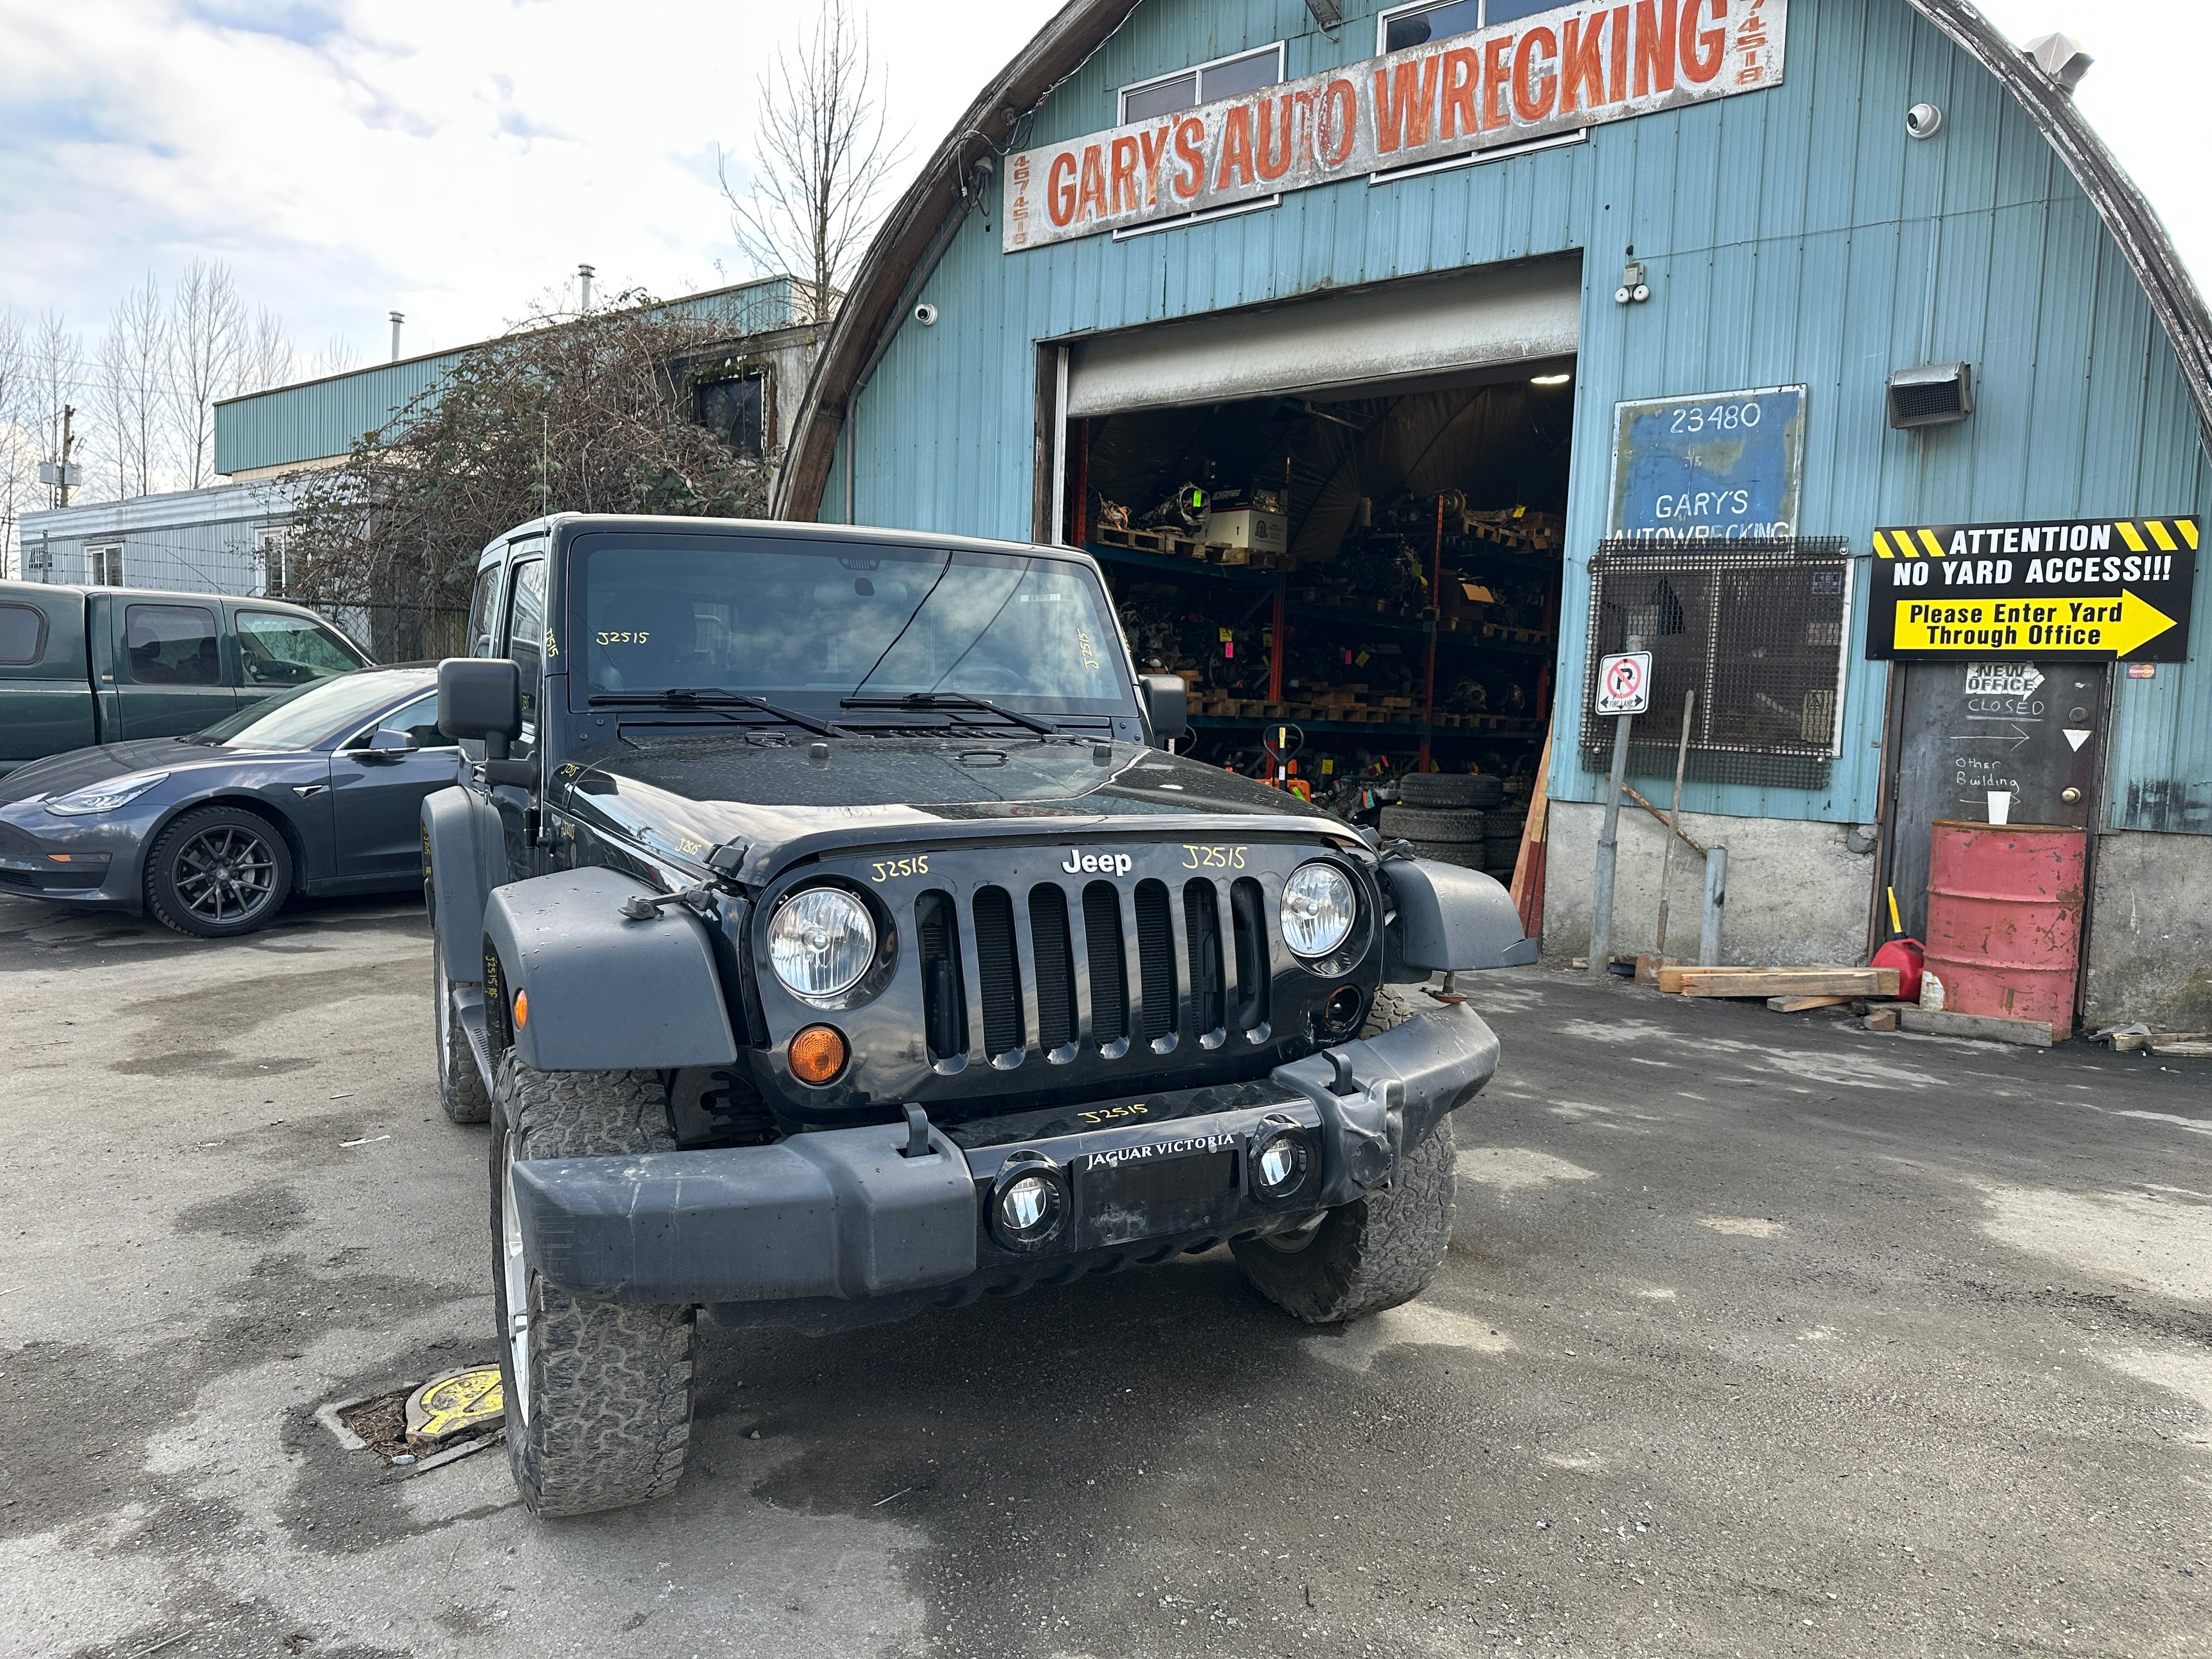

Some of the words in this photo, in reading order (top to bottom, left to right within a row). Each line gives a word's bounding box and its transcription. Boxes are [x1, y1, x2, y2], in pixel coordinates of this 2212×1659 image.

[1047, 115, 1205, 228] GARY'S
[1217, 78, 1357, 190] AUTO
[1374, 0, 1728, 154] WRECKING
[1671, 403, 1761, 433] 23480
[1656, 490, 1749, 518] GARY'S
[1949, 524, 2111, 555] ATTENTION
[1893, 561, 1929, 586] NO
[1942, 559, 2013, 585] YARD
[2025, 555, 2172, 584] ACCESS!!!
[1910, 604, 1983, 623] Please
[1994, 603, 2057, 623] Enter
[2070, 602, 2123, 622] Yard
[596, 631, 650, 645] J2515
[1927, 625, 2017, 647] Through
[2028, 624, 2101, 645] Office
[1077, 628, 1099, 669] J2515
[1978, 664, 2024, 677] NEW
[1968, 679, 2035, 691] OFFICE
[1609, 700, 1620, 708] FIRE
[1620, 699, 1634, 708] LANE
[1968, 698, 2044, 715] CLOSED
[1956, 771, 2020, 796] Building
[872, 855, 929, 882] J2515
[1062, 849, 1132, 877] Jeep
[1182, 844, 1248, 869] J2515
[1077, 1103, 1149, 1123] J2515
[1086, 1145, 1153, 1171] JAGUAR
[1155, 1134, 1234, 1155] VICTORIA
